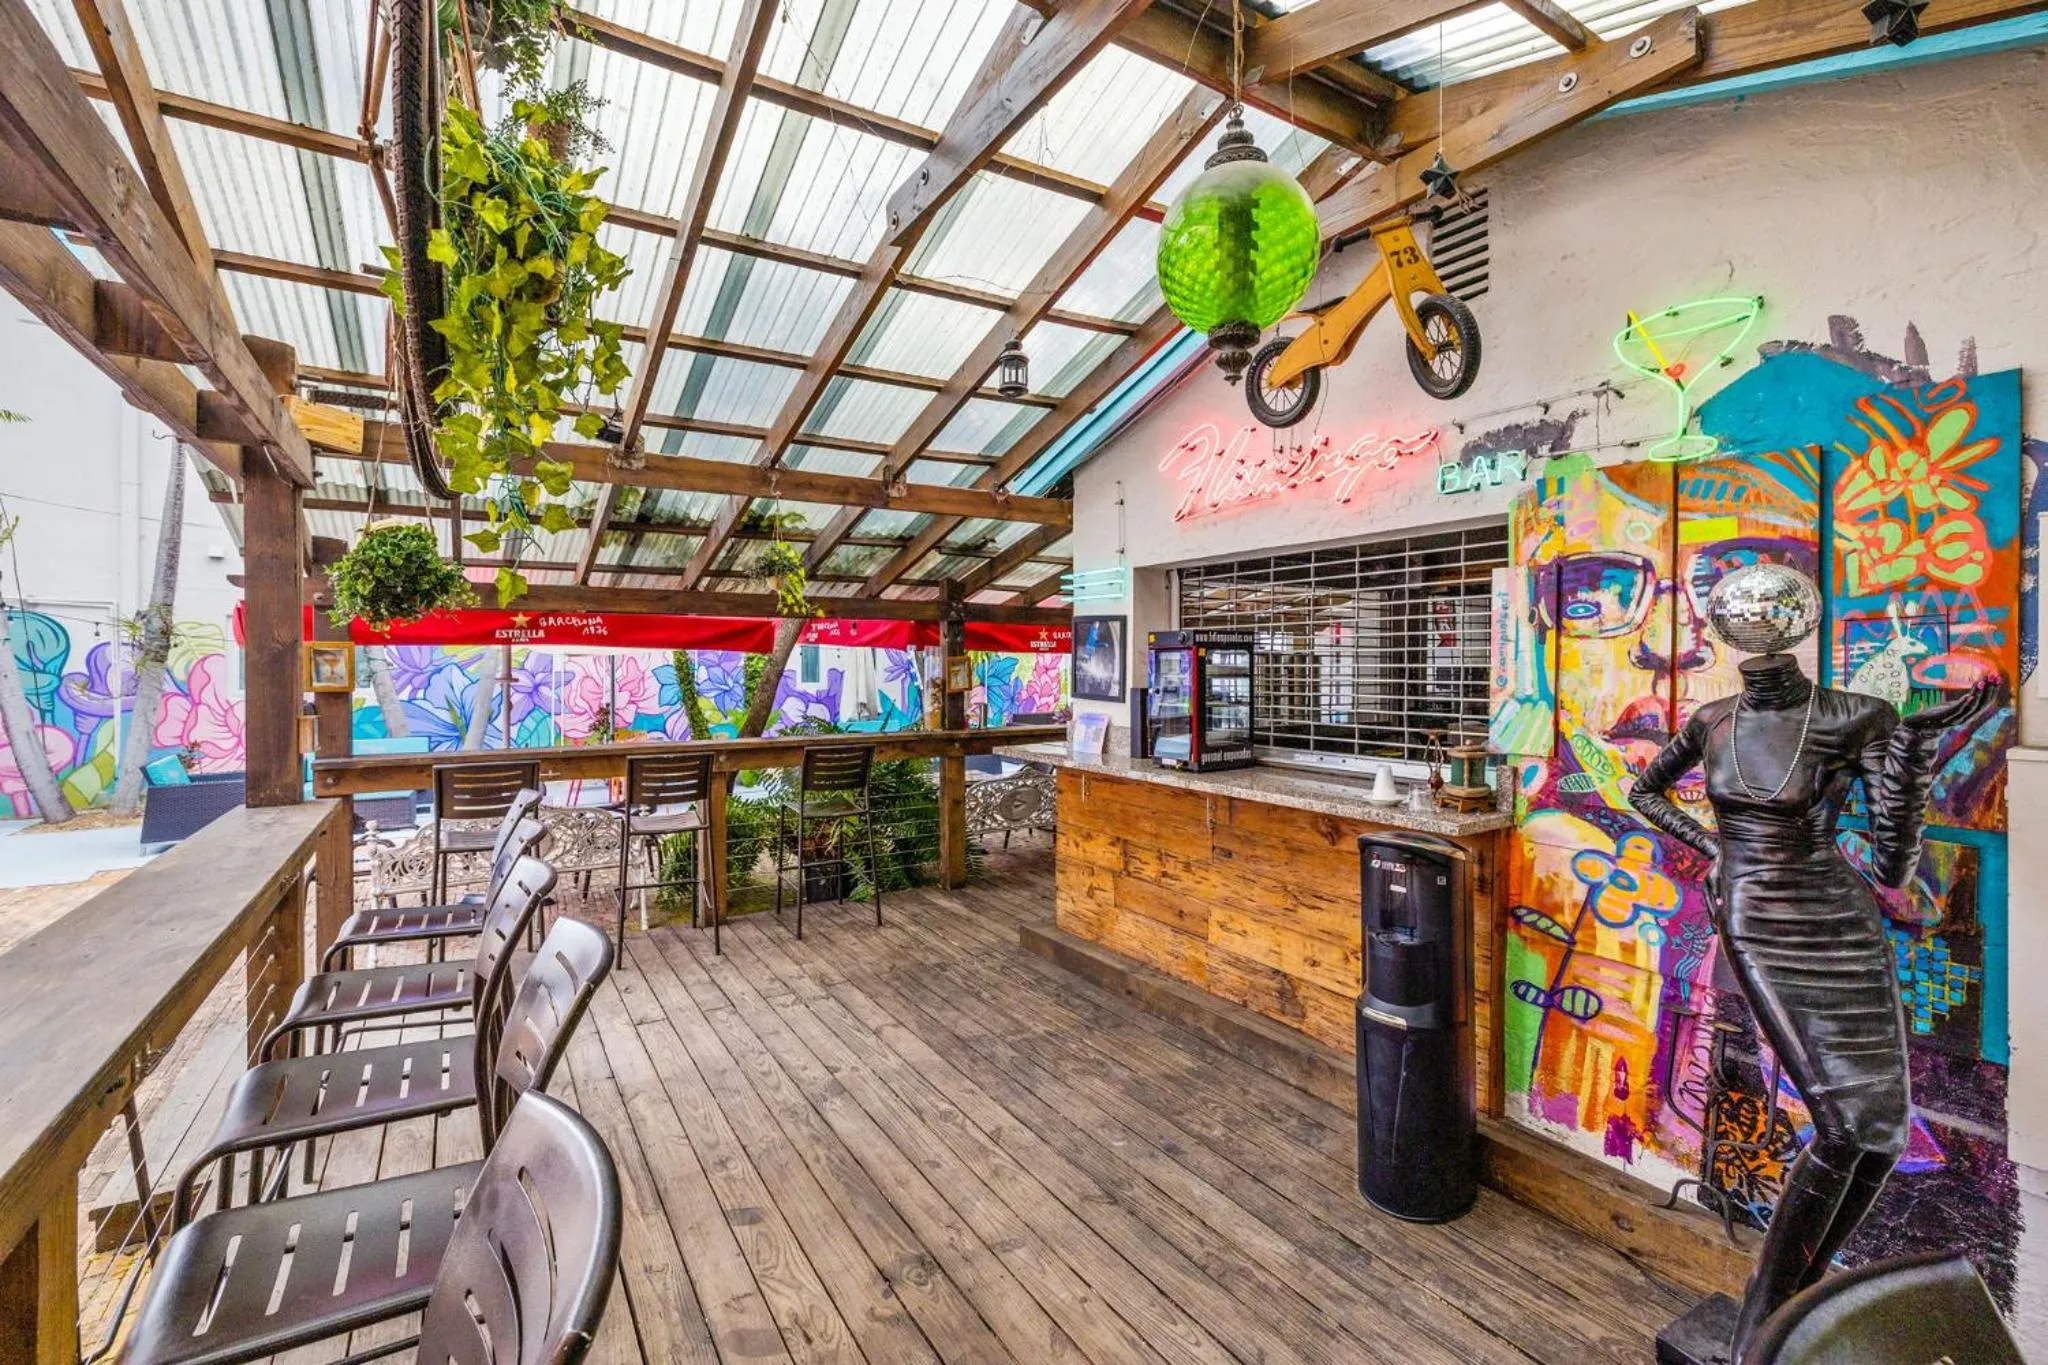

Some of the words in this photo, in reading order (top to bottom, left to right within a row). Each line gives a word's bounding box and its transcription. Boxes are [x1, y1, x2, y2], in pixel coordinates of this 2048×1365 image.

[1389, 246, 1420, 268] 73
[1158, 424, 1438, 521] Flamingo
[1437, 450, 1527, 495] BAR
[538, 615, 604, 628] BARCELONA
[495, 628, 546, 639] ESTRELLA
